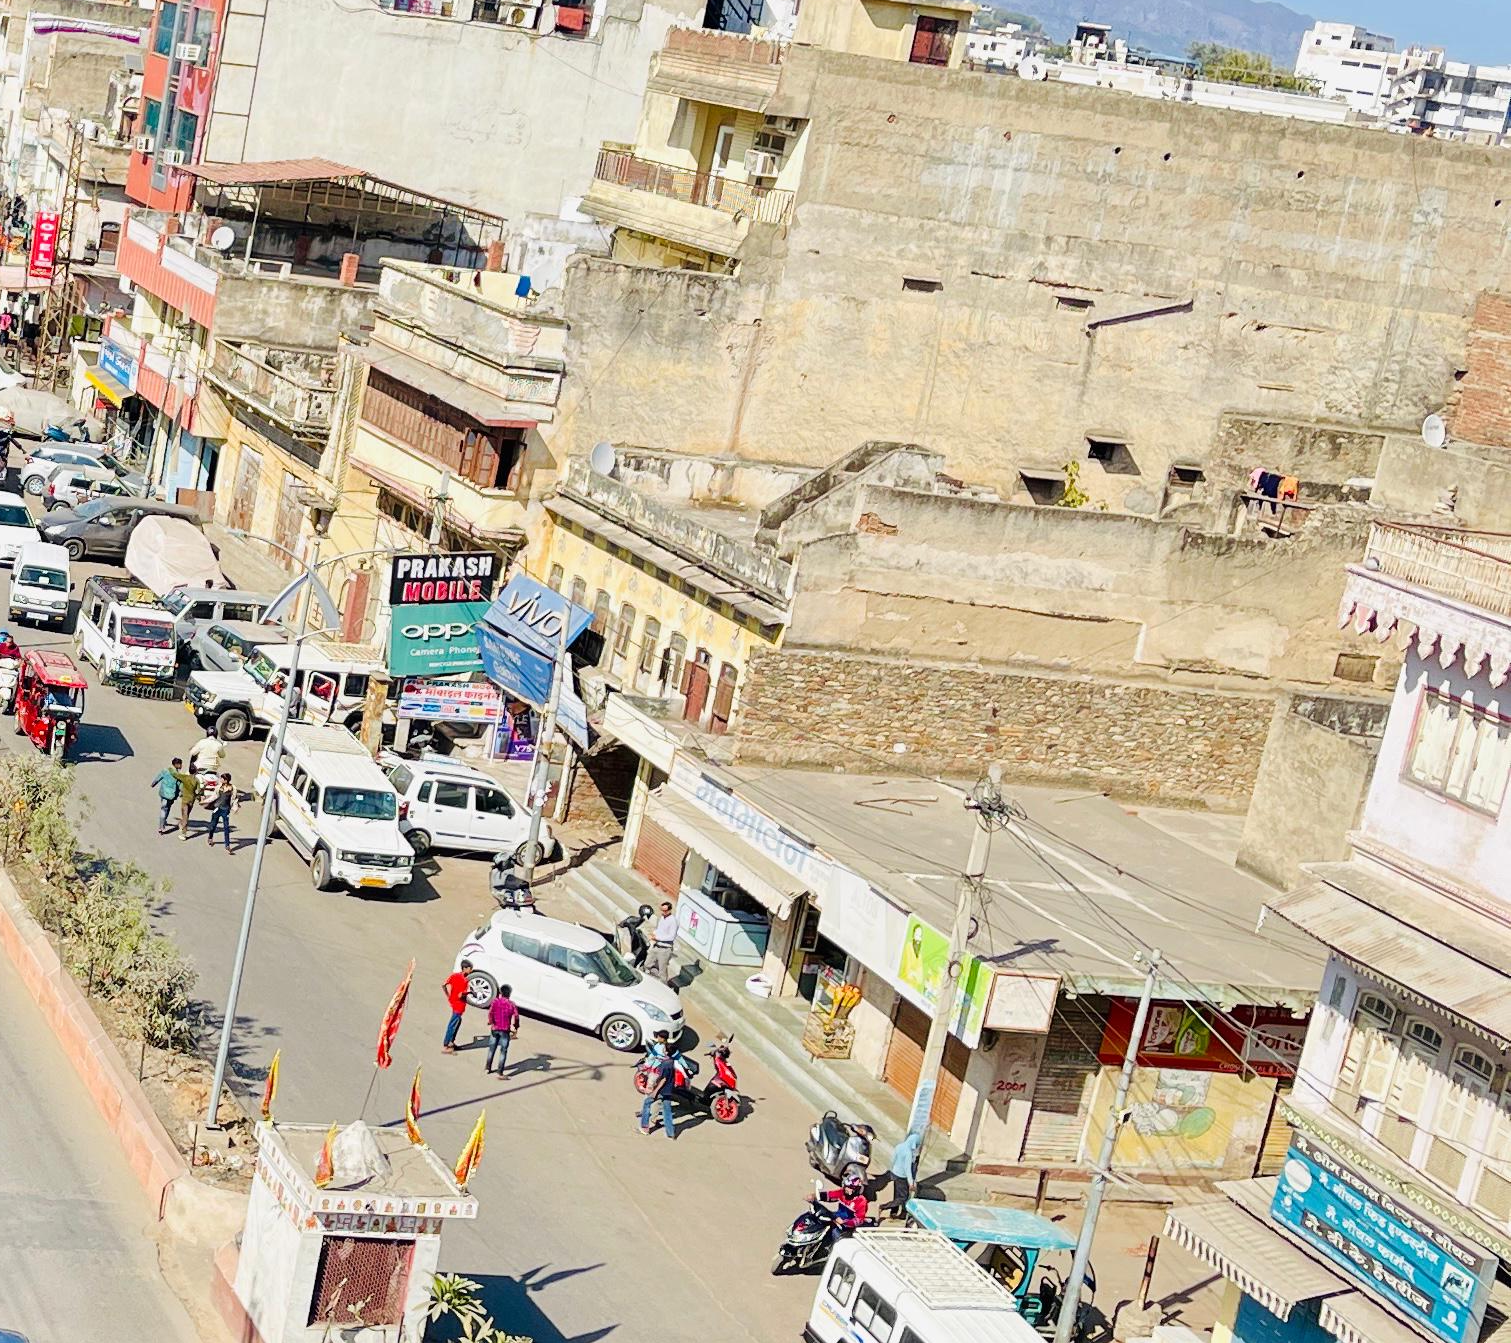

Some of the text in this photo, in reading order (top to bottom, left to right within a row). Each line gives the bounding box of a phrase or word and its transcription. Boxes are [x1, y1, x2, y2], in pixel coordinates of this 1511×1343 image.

[38, 212, 56, 262] HOTEL
[396, 556, 493, 579] PRAKASH
[402, 580, 482, 602] MOBILE
[507, 592, 562, 638] vivo
[410, 647, 444, 657] Camera
